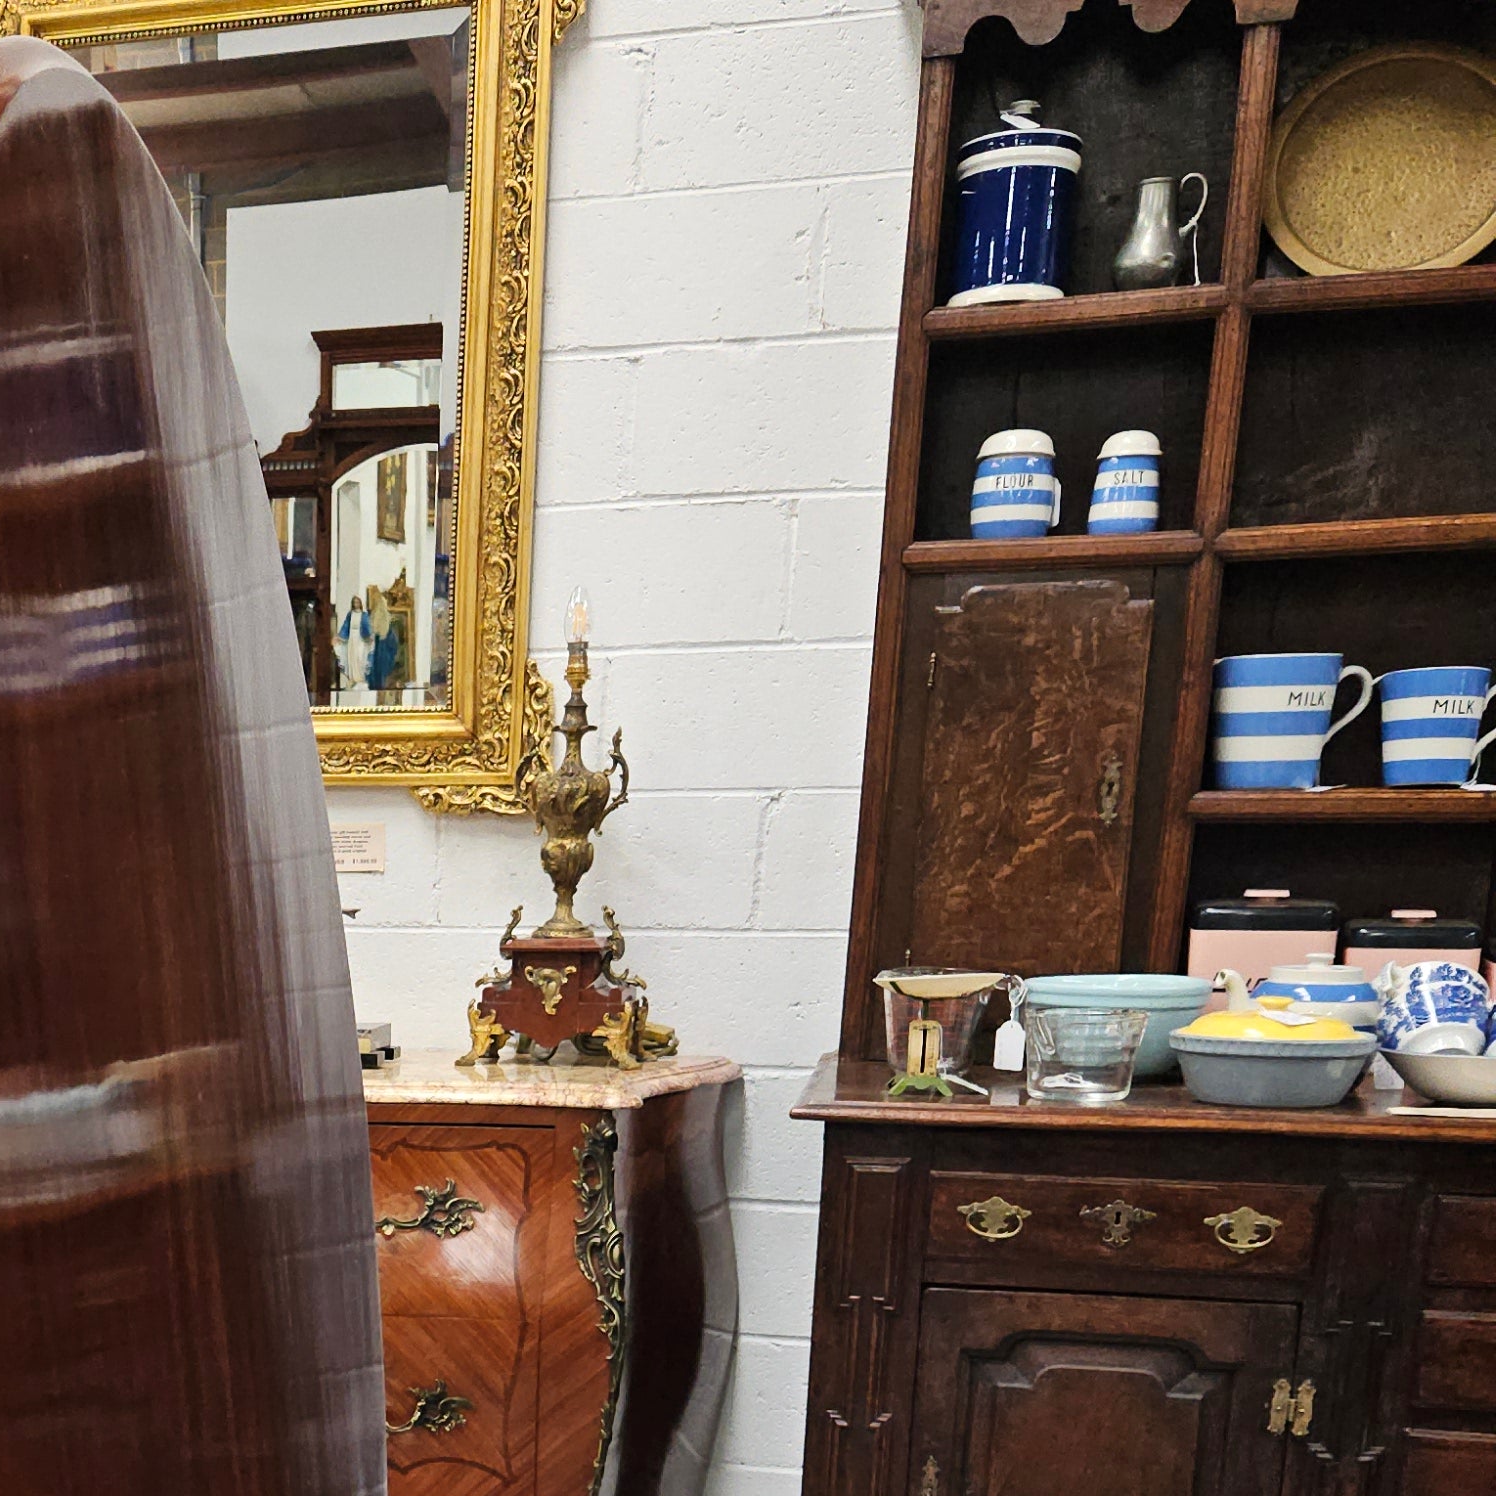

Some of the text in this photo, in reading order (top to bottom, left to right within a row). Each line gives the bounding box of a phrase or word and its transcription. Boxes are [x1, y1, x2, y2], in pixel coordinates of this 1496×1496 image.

[995, 475, 1034, 489] FLOUR
[1113, 471, 1145, 486] SALT
[1287, 691, 1327, 707] MILK
[1432, 699, 1476, 715] MILK
